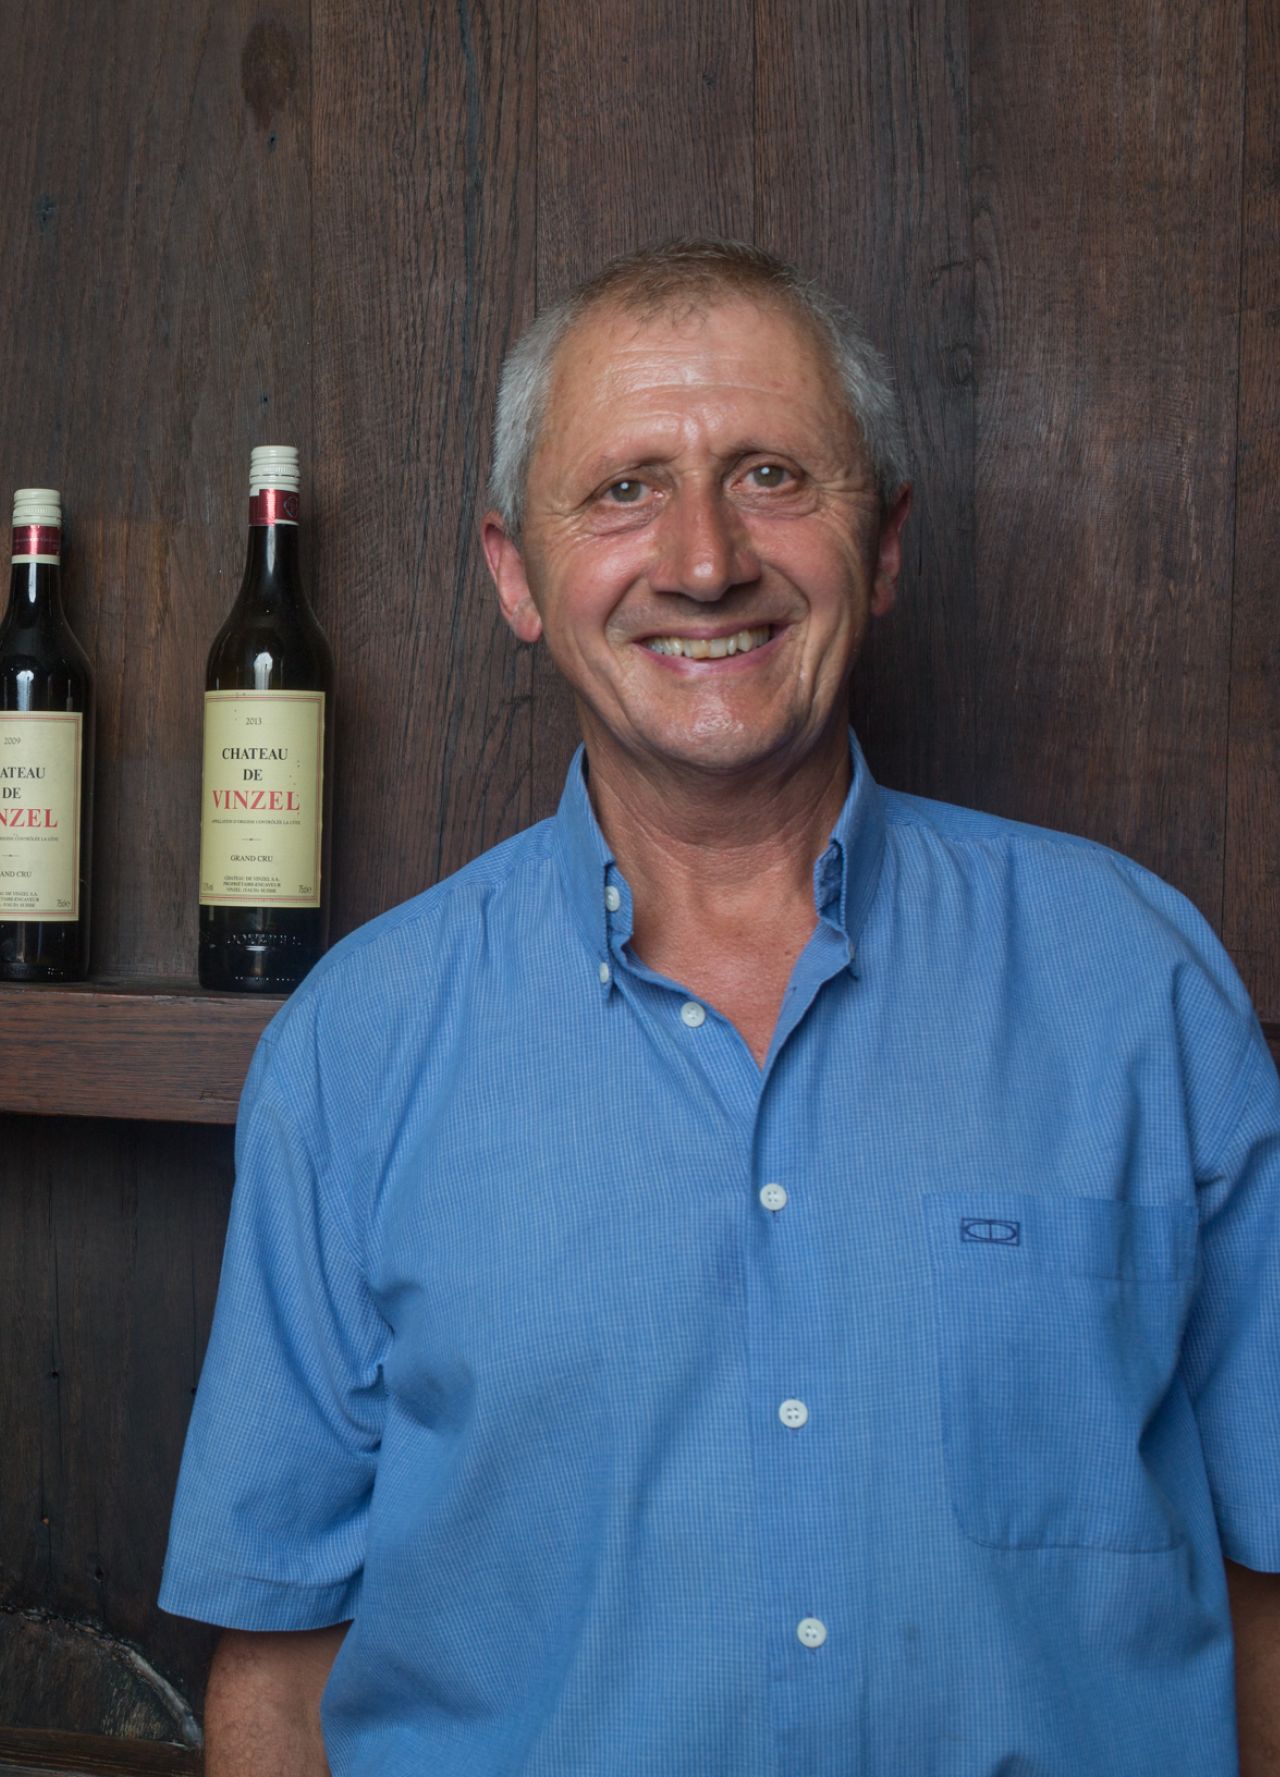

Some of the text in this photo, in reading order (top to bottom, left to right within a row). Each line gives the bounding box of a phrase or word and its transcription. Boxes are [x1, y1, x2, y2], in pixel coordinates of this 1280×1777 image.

[245, 717, 262, 725] 2013
[3, 736, 21, 745] 2009
[221, 747, 288, 760] CHATEAU
[243, 768, 263, 781] DE
[2, 787, 21, 799] DE
[212, 790, 300, 811] VINZEL
[230, 854, 256, 862] GRAND
